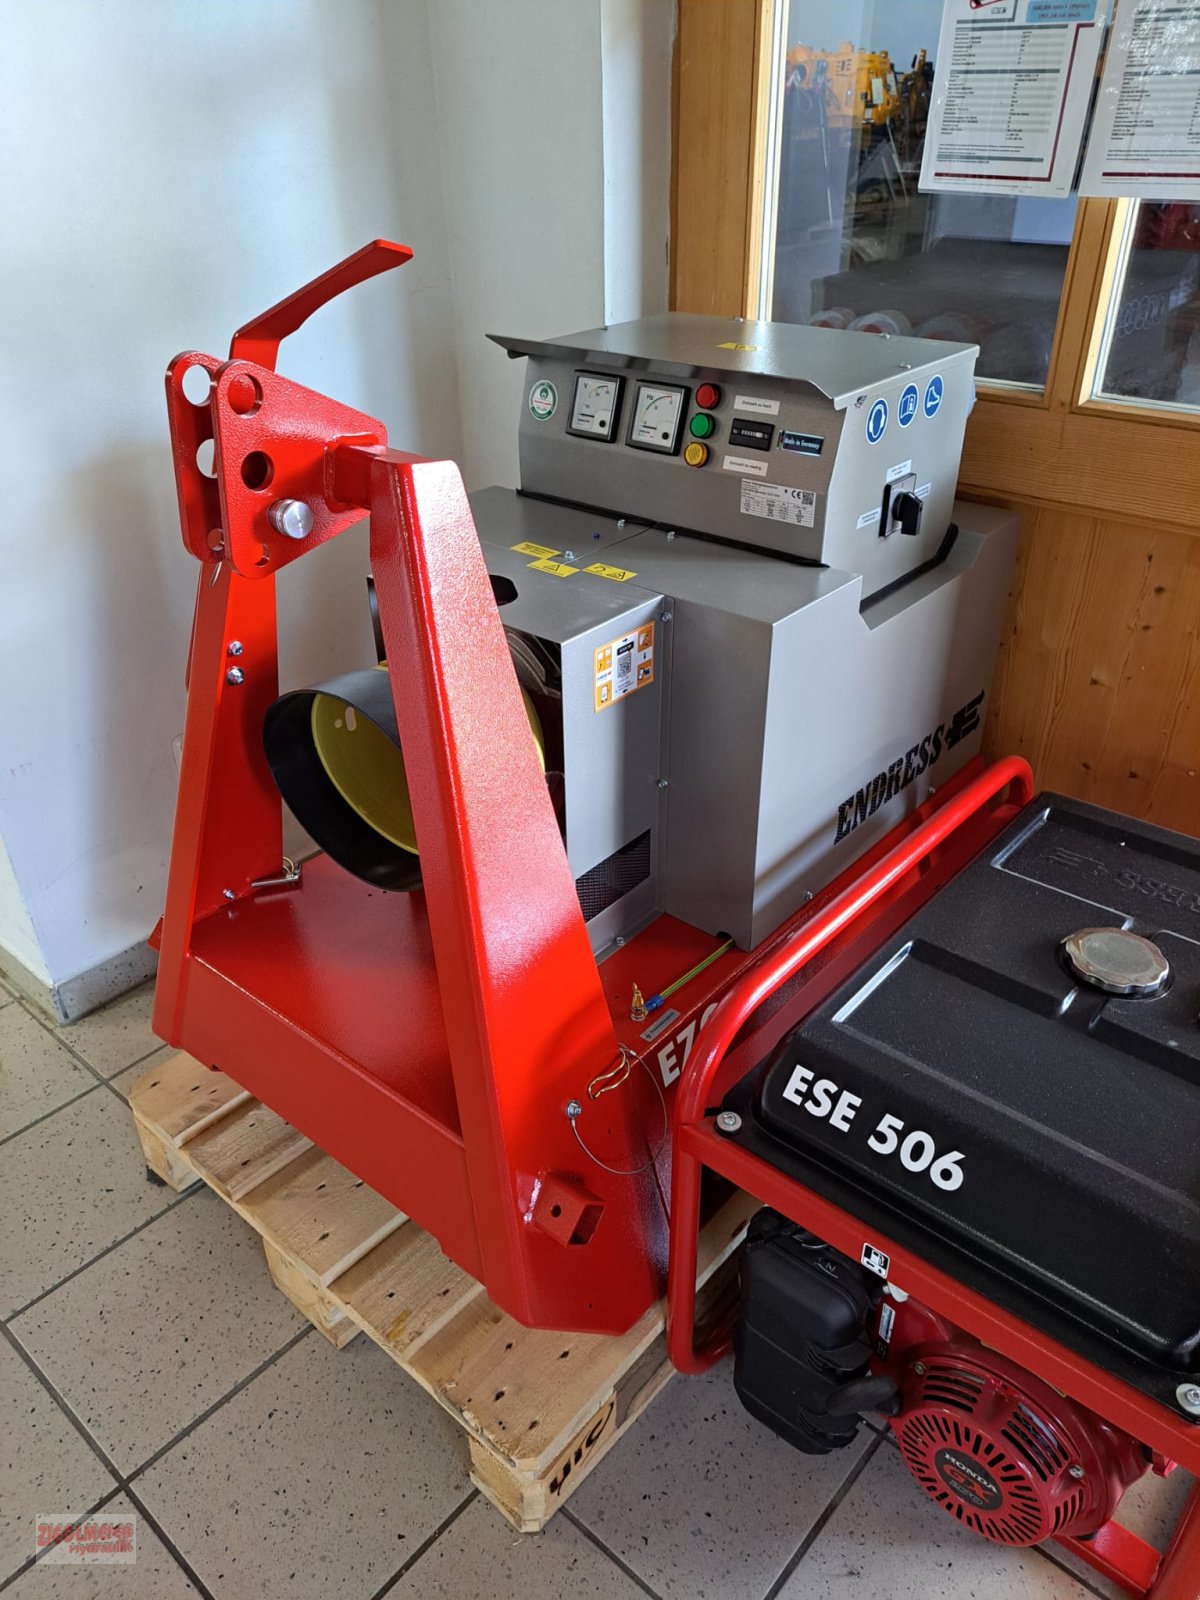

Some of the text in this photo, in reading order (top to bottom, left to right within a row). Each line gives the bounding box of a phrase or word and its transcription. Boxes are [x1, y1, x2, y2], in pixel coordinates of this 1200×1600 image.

[801, 439, 821, 450] Germany
[833, 722, 946, 846] ENDRESS
[782, 1064, 967, 1192] ESE 506
[943, 1452, 998, 1495] HONDA
